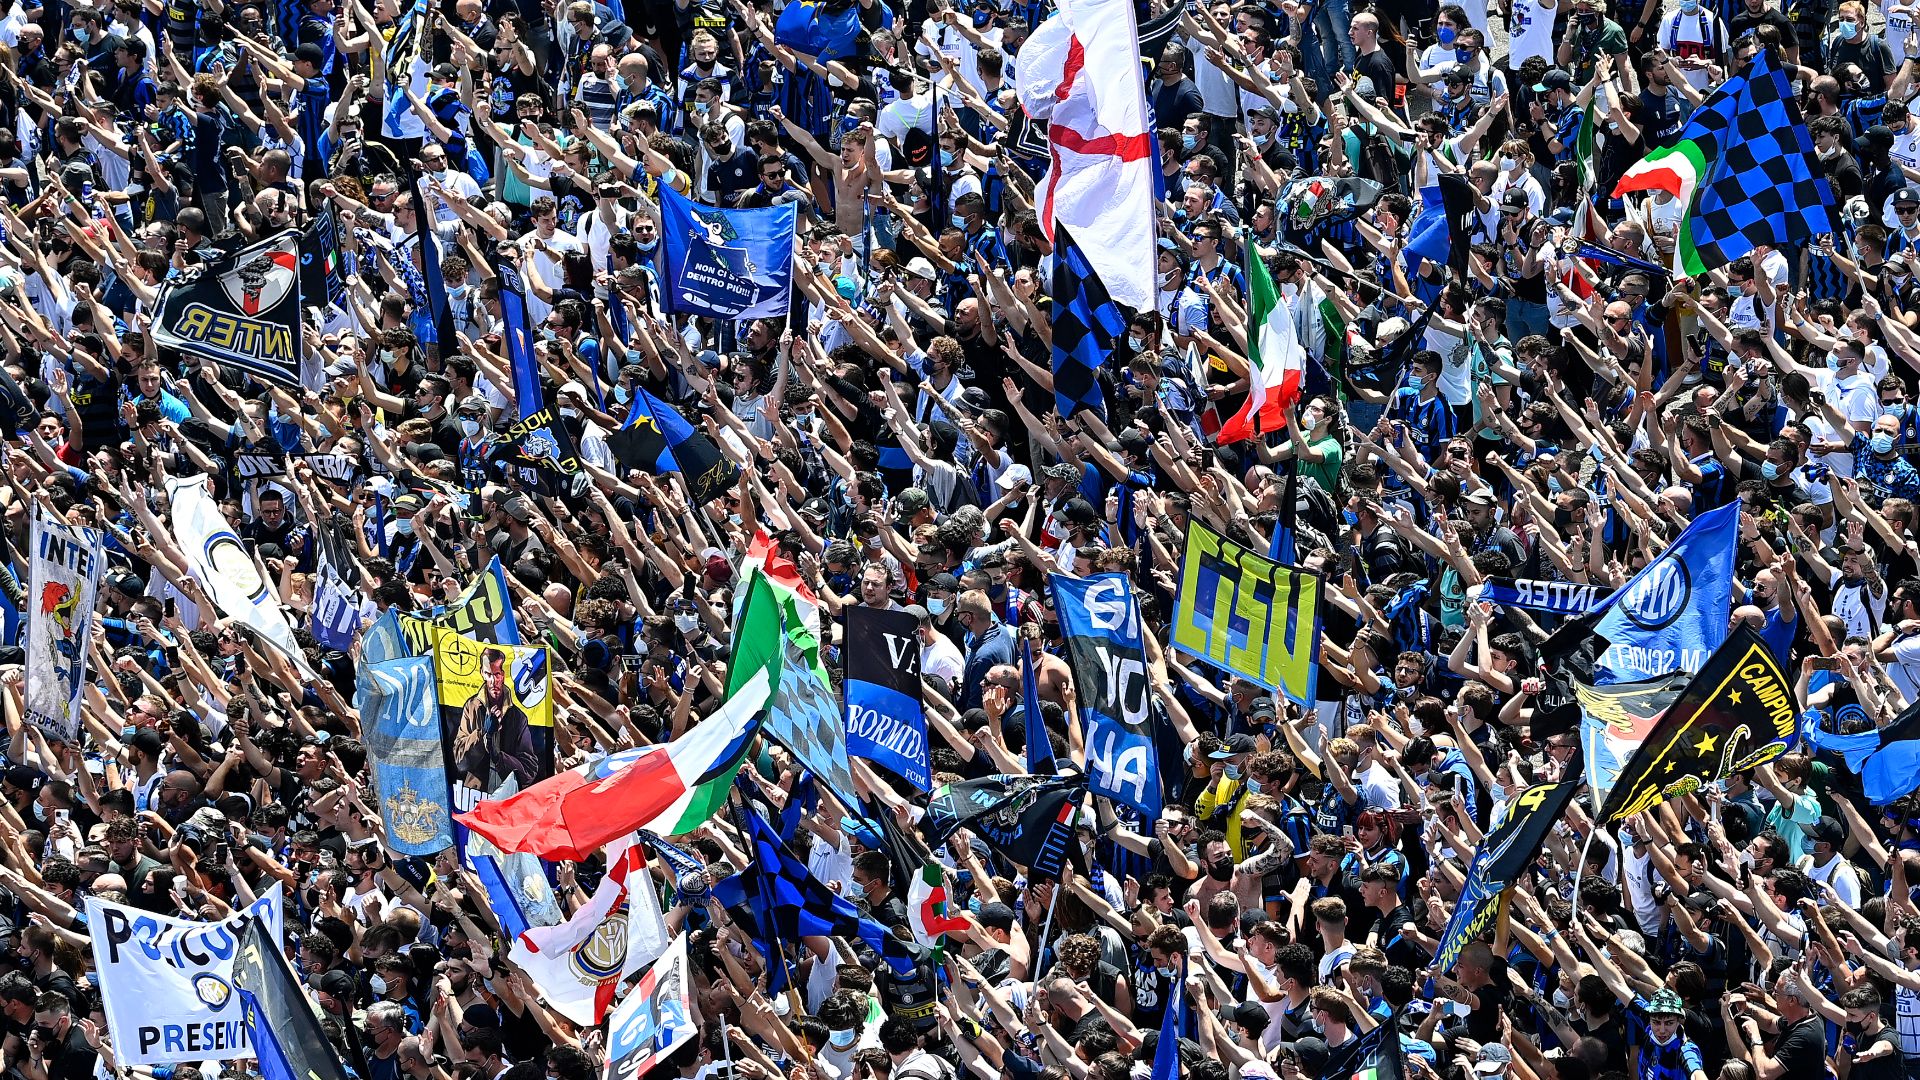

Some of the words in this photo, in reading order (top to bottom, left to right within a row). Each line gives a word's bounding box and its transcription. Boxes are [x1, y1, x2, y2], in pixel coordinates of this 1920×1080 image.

[686, 271, 725, 287] DENTRO
[726, 282, 751, 298] PIÙ!!!
[695, 262, 716, 275] NON
[717, 269, 728, 278] CI
[39, 531, 95, 585] INTER
[1739, 663, 1795, 739] CAMPIONI
[846, 704, 927, 767] BORMIDA
